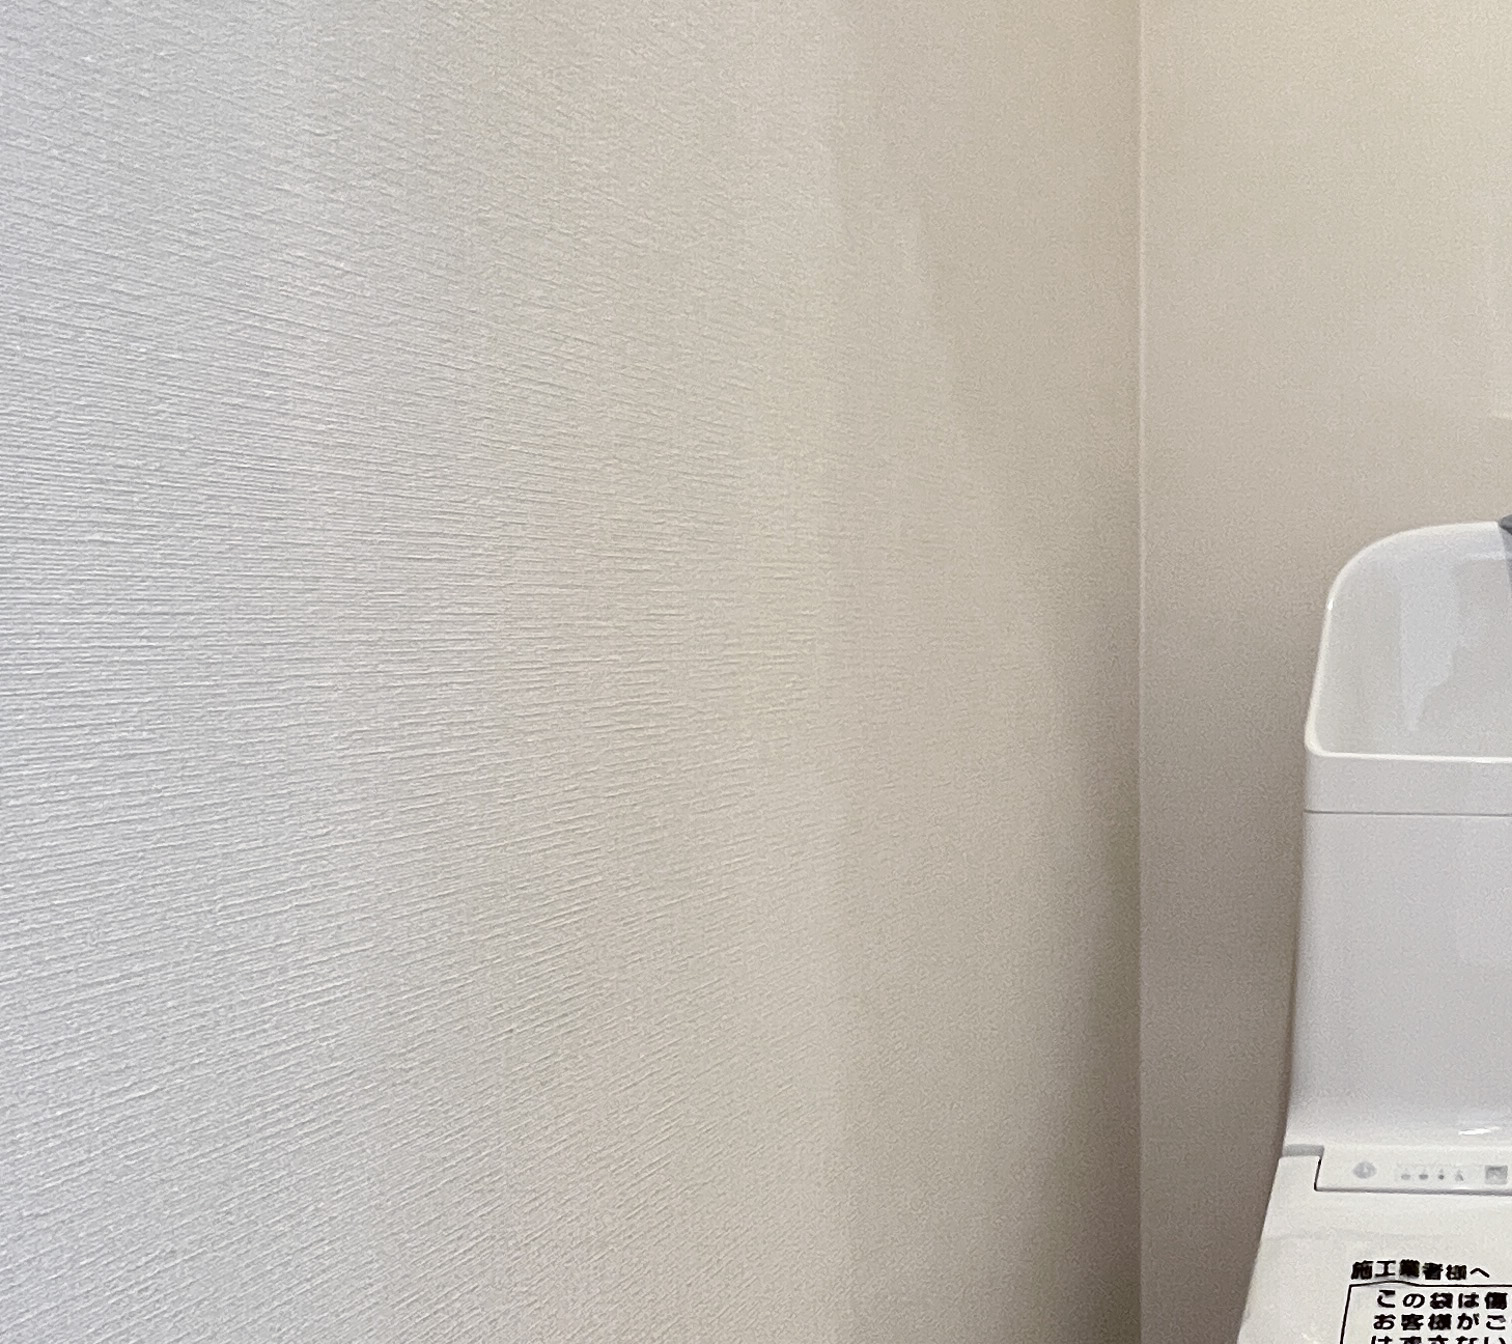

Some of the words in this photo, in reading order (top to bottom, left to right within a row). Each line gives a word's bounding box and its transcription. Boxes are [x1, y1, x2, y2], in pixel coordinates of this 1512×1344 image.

[1350, 1259, 1490, 1281] 施工業者様へ
